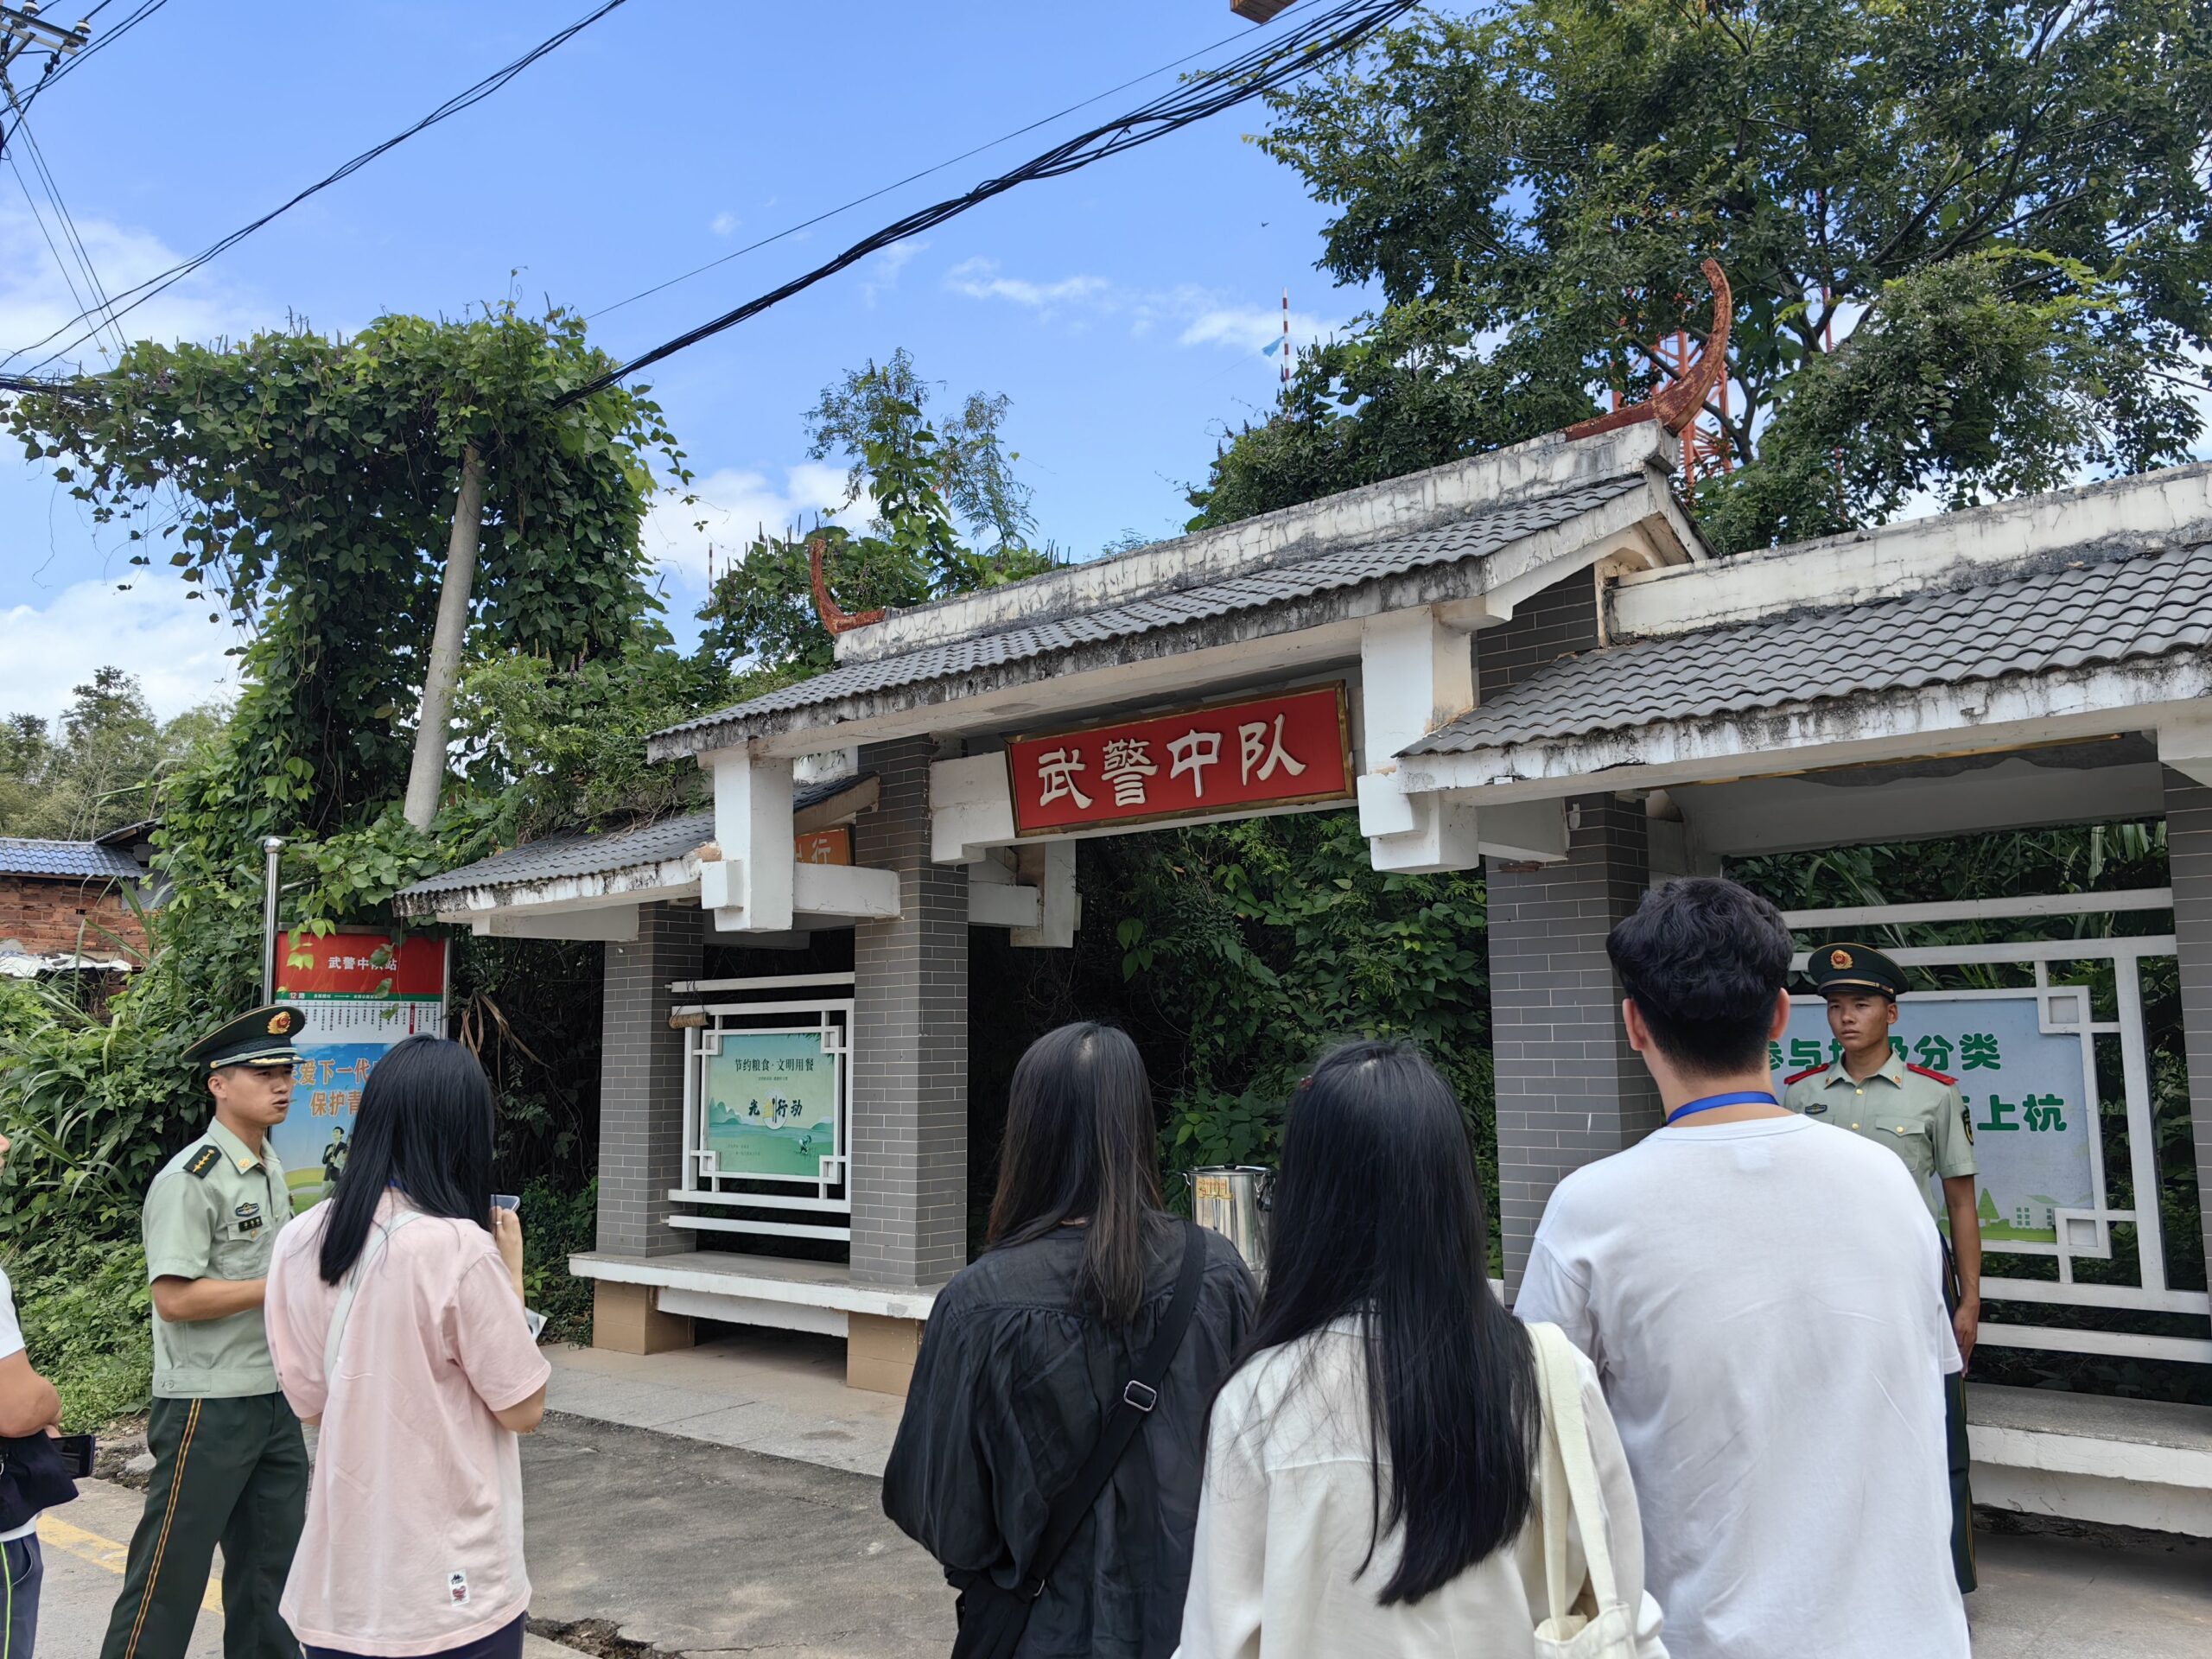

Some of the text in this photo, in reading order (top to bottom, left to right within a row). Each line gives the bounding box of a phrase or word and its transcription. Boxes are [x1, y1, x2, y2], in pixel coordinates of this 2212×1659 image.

[1038, 714, 1306, 810] 武警中队
[290, 1058, 381, 1085] 爱下一代
[1961, 1093, 2068, 1133] 上杭
